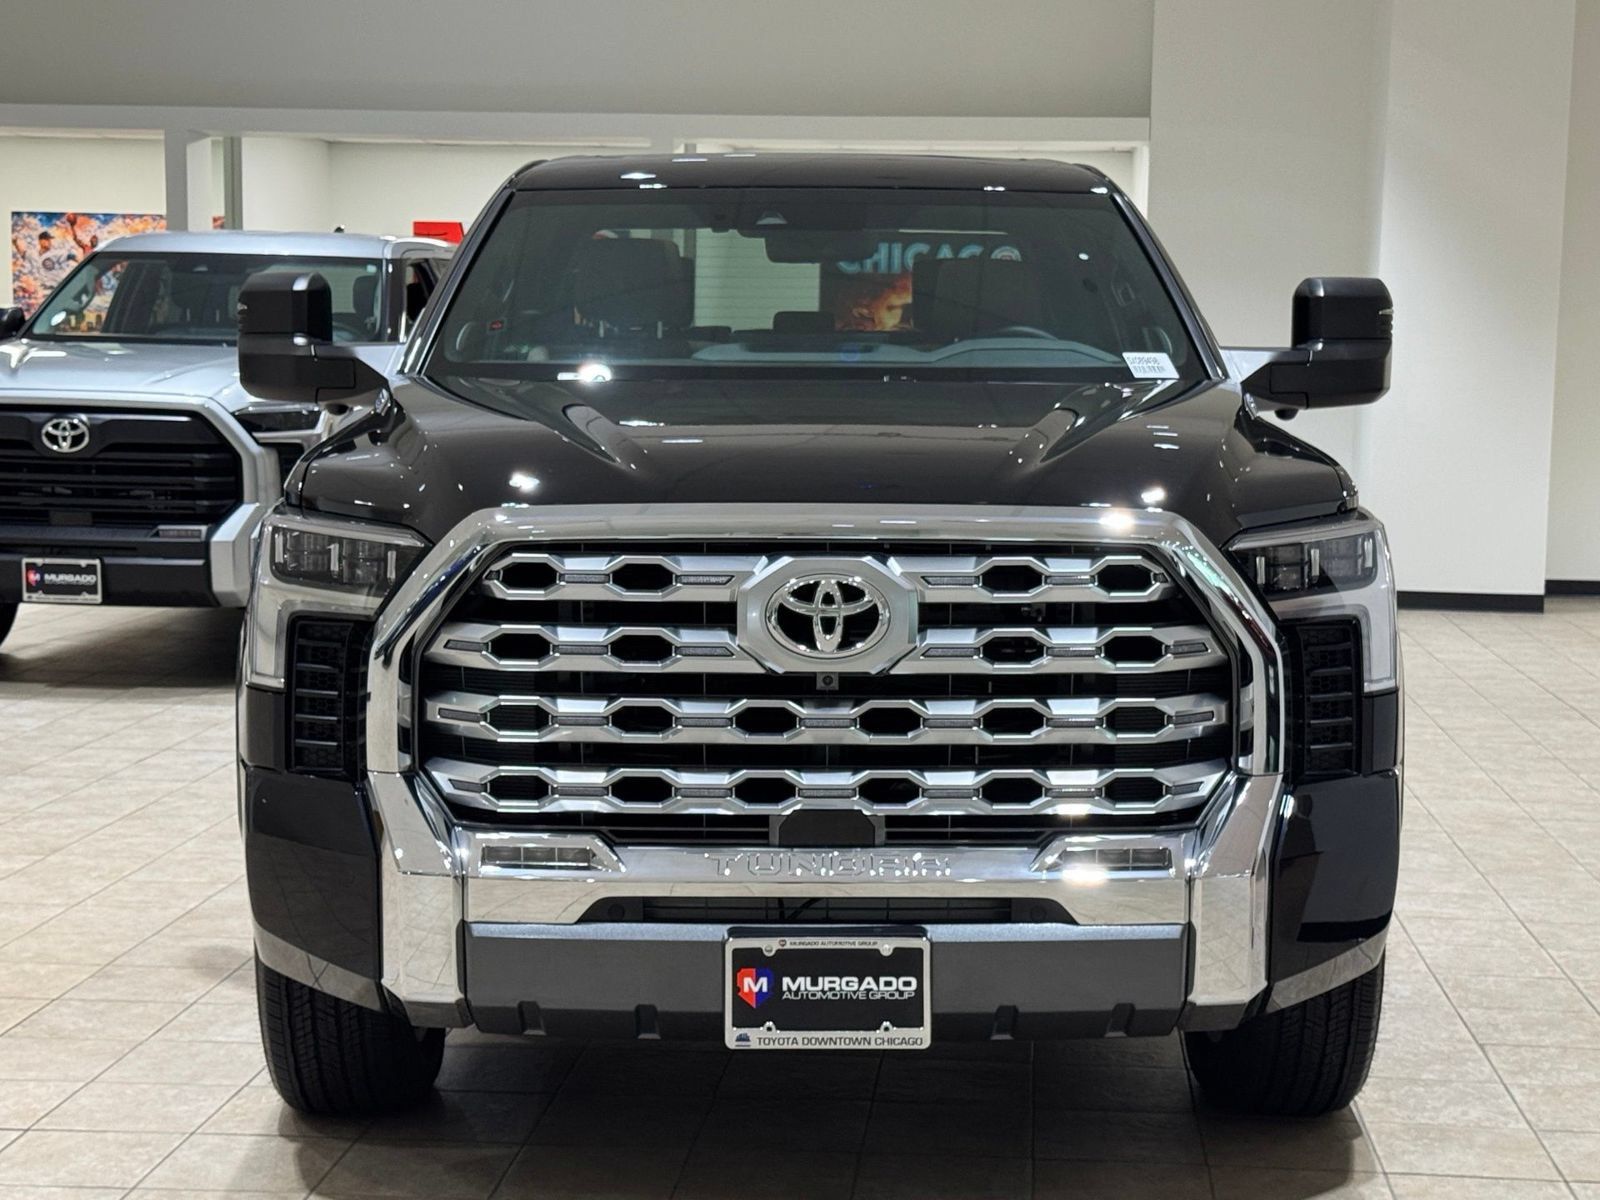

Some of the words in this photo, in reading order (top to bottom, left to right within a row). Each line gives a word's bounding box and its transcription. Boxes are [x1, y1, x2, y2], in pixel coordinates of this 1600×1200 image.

[44, 573, 96, 582] MURGADO
[704, 852, 951, 877] TUNDRA
[743, 977, 768, 992] M
[782, 976, 917, 991] MURGADO
[781, 991, 867, 1000] AUTOMOTIVE
[868, 991, 916, 1000] GROUP
[757, 1036, 799, 1046] TOYOTA
[801, 1036, 871, 1047] DOWNTOWN
[874, 1036, 924, 1047] CHICAGO
